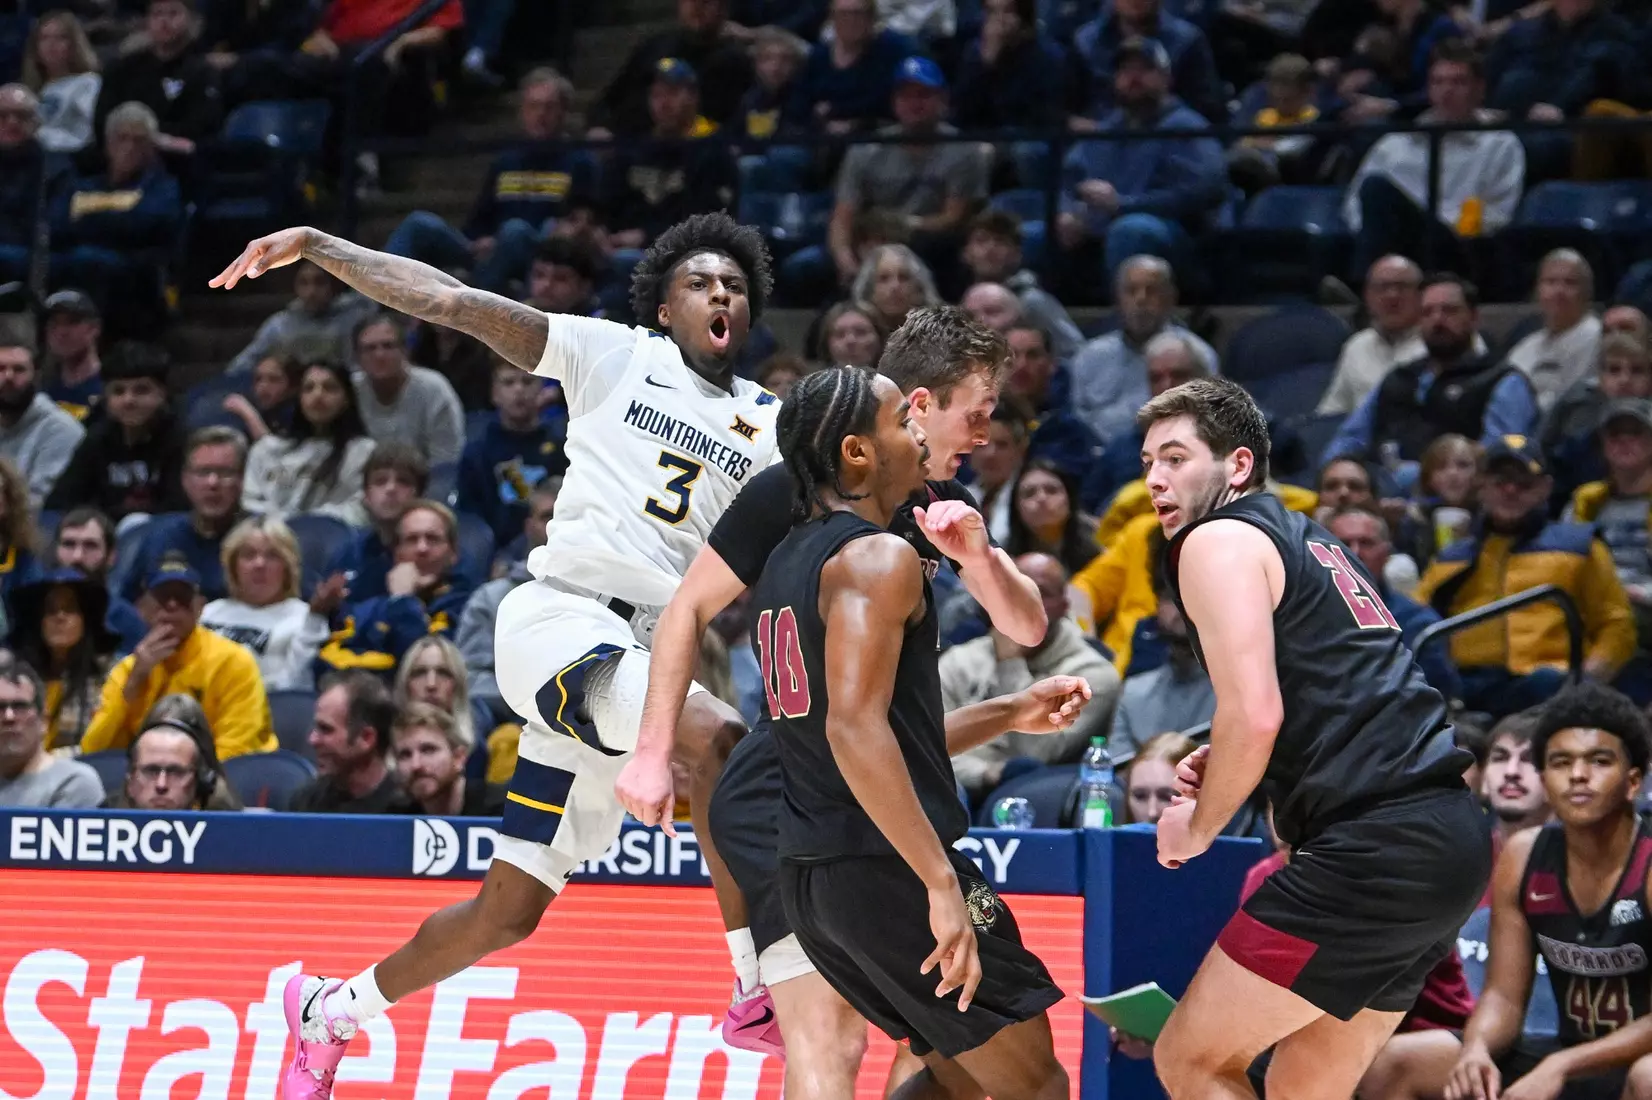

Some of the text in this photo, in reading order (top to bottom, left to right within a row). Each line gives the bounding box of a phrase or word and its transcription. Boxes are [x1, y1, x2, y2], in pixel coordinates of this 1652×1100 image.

[623, 399, 753, 482] MOUNTAINEERS
[643, 450, 703, 526] 3
[1307, 541, 1402, 632] 21
[758, 606, 811, 720] 10
[10, 816, 207, 864] ENERGY
[1567, 977, 1634, 1039] 44
